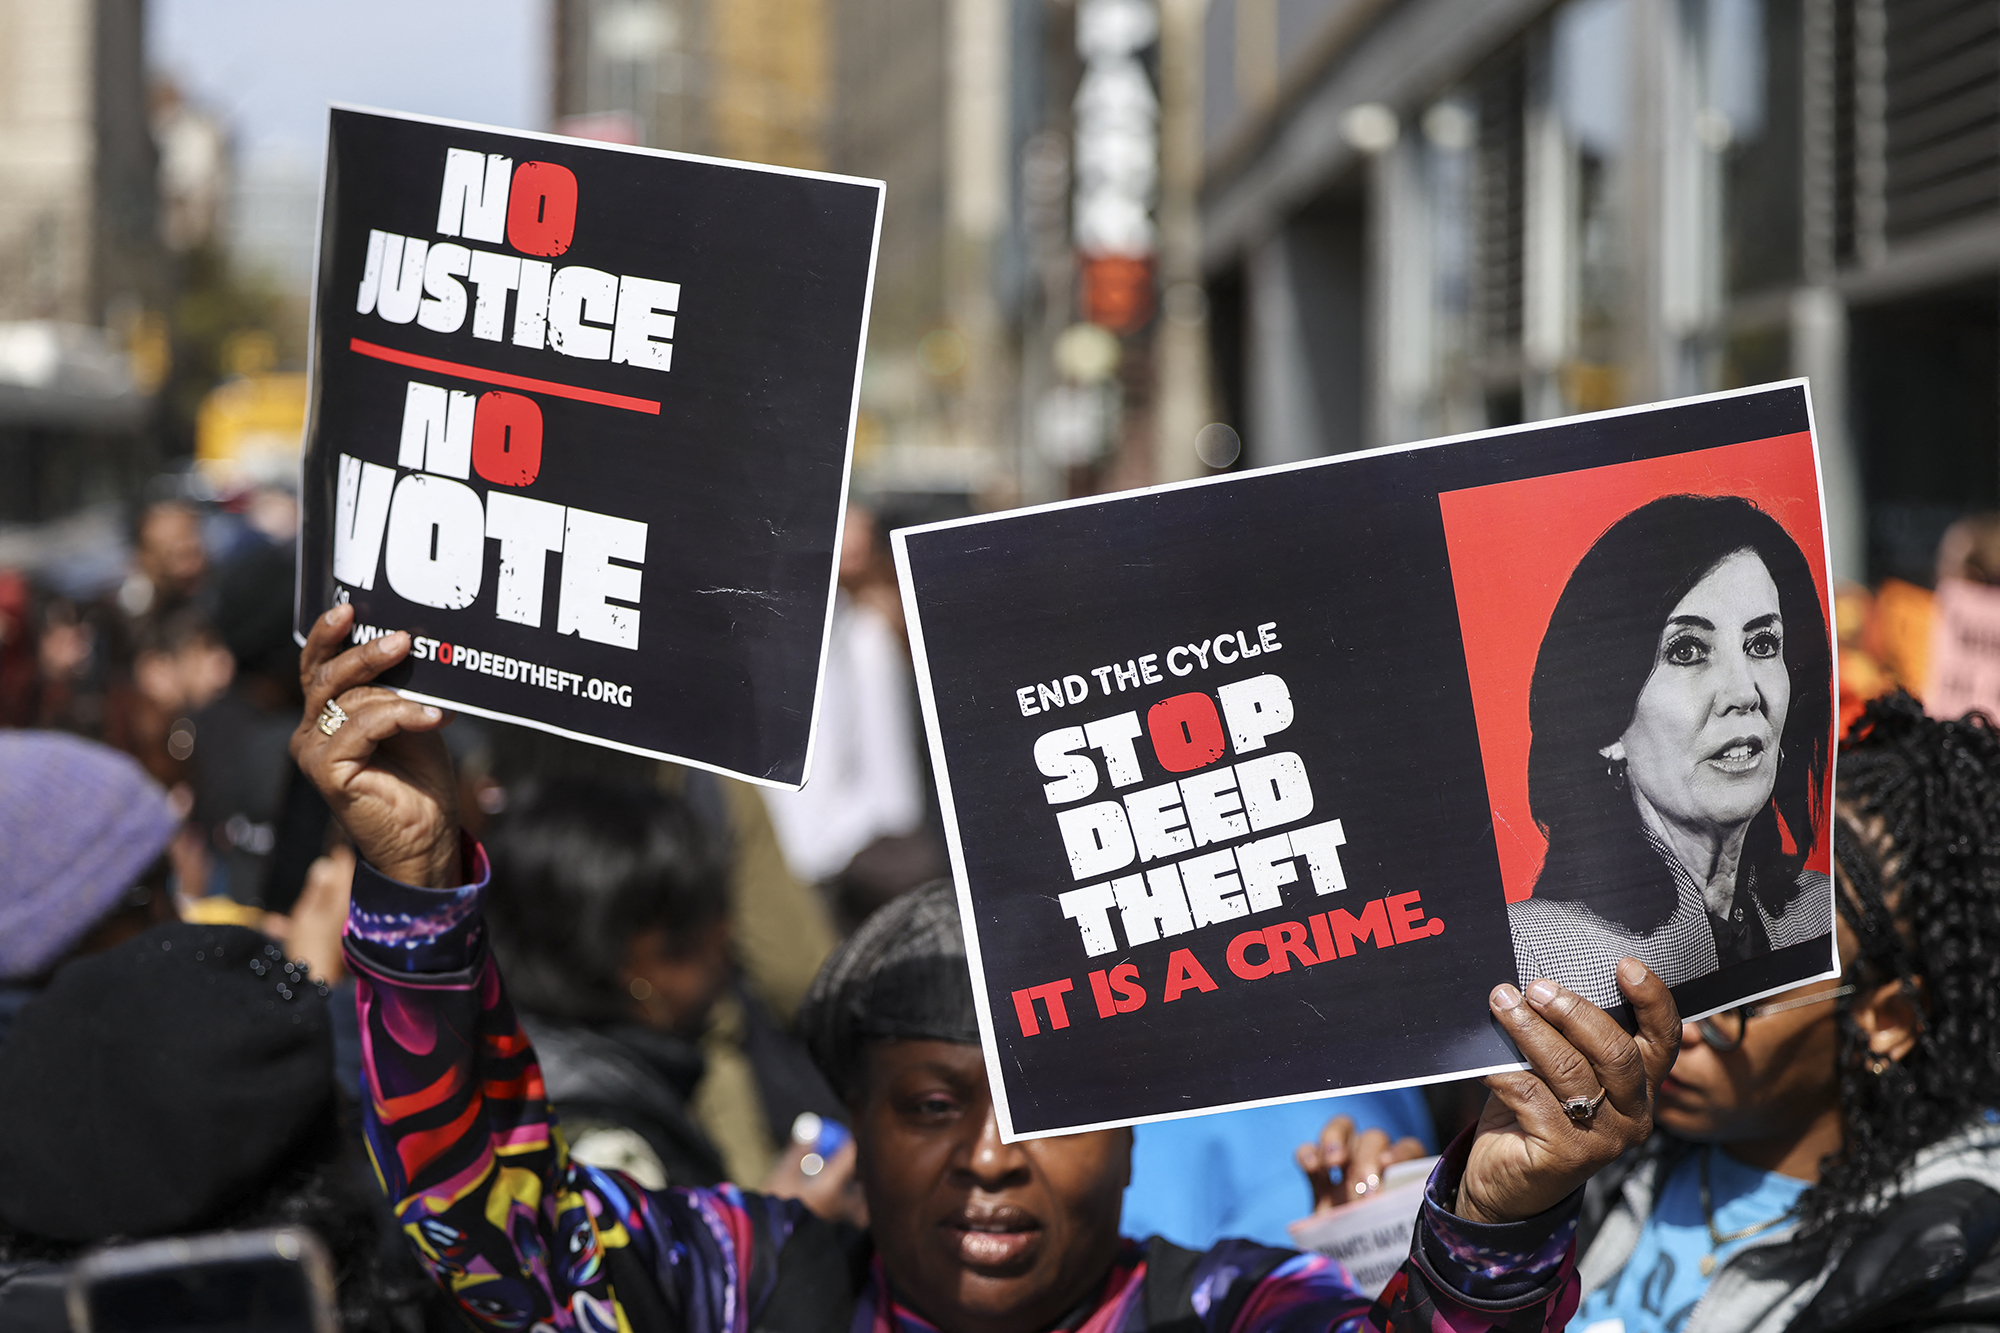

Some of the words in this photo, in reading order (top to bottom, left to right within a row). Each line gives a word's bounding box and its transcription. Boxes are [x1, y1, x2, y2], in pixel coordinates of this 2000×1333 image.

[437, 148, 578, 257] NO
[356, 229, 681, 372] JUSTICE
[398, 381, 543, 488] NO
[333, 453, 649, 651] VOTE
[352, 623, 633, 708] W.STOPDEEDTHEFT.ORG
[1017, 680, 1088, 717] END
[1091, 654, 1163, 696] THE
[1167, 622, 1282, 676] CYCLE
[1034, 674, 1294, 804] STOP
[1056, 751, 1314, 881] DEED
[1058, 819, 1348, 958] THEFT
[1011, 978, 1074, 1037] IT
[1088, 963, 1147, 1019] IS
[1163, 948, 1219, 1003] A
[1226, 890, 1445, 980] CRIME.
